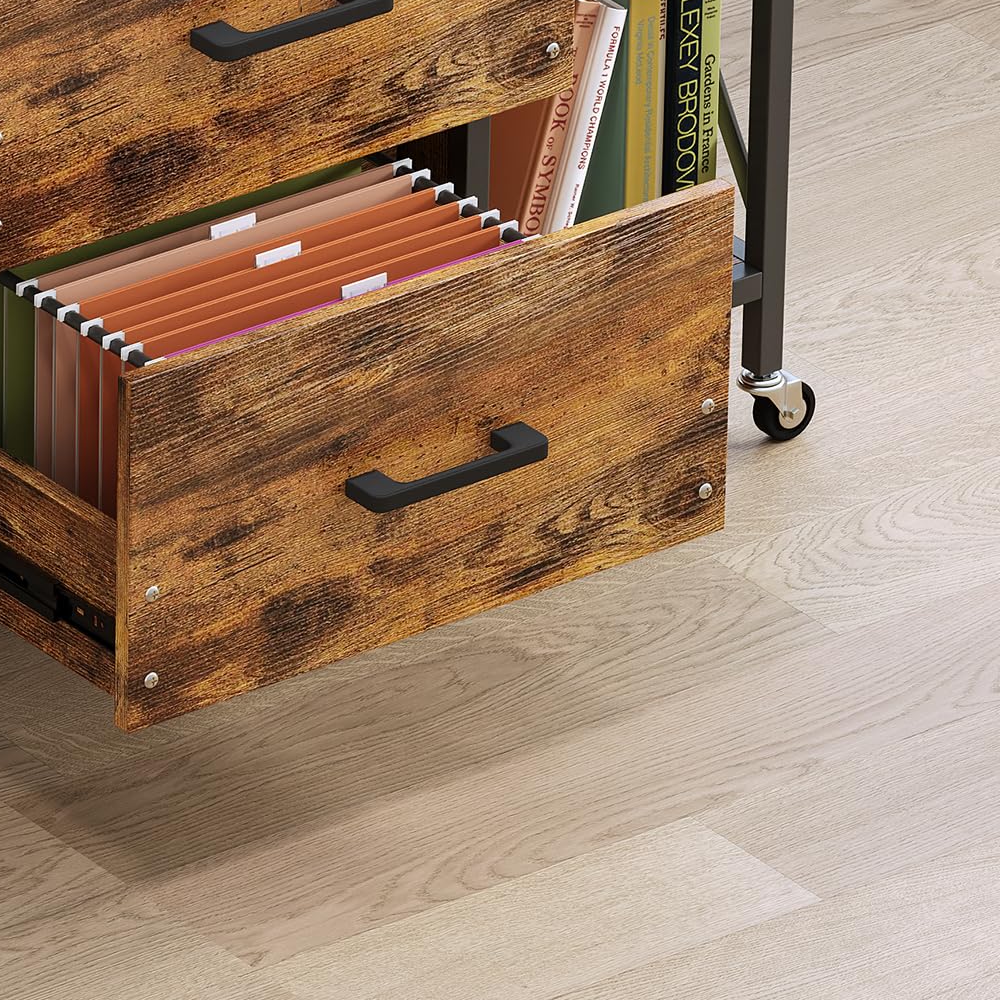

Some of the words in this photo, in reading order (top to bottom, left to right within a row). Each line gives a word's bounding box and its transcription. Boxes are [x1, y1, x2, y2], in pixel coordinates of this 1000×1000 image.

[603, 25, 621, 70] FORMULA
[592, 78, 607, 114] WORLD
[644, 51, 655, 108] Contemporary
[703, 53, 717, 110] Gardens
[703, 111, 716, 121] in
[546, 136, 556, 149] OF
[577, 114, 598, 170] CHAMPIONS
[702, 125, 715, 174] France
[522, 155, 557, 235] SYMBO
